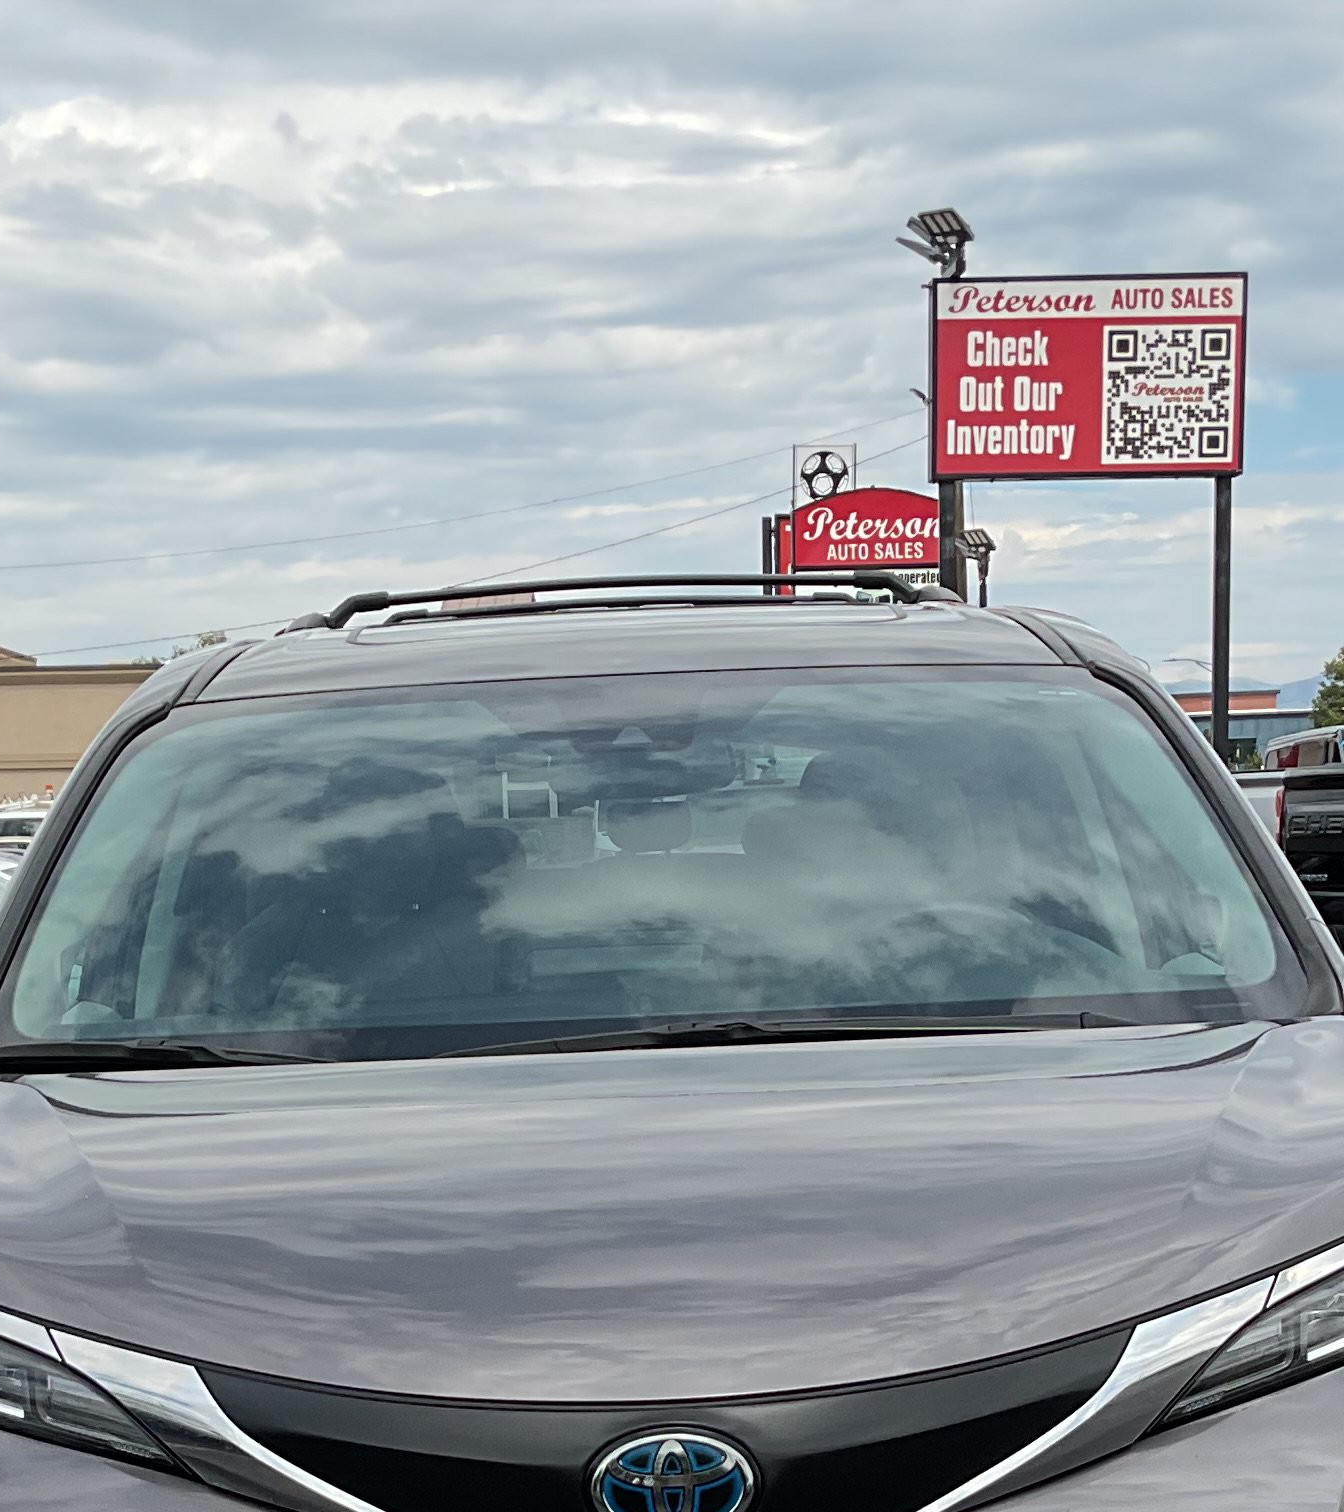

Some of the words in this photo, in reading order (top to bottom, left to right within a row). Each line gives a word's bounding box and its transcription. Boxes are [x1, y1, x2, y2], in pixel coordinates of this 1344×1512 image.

[948, 286, 1096, 313] Peterson
[1111, 289, 1164, 309] AUTO
[1171, 287, 1233, 308] SALES
[966, 330, 1049, 367] Check
[959, 376, 1004, 412] Out
[1013, 376, 1063, 411] Our
[1132, 382, 1205, 396] Peterson
[946, 419, 1075, 460] Inventory
[803, 507, 940, 541] Peterson
[826, 543, 869, 561] AUTO
[874, 541, 924, 560] SALES
